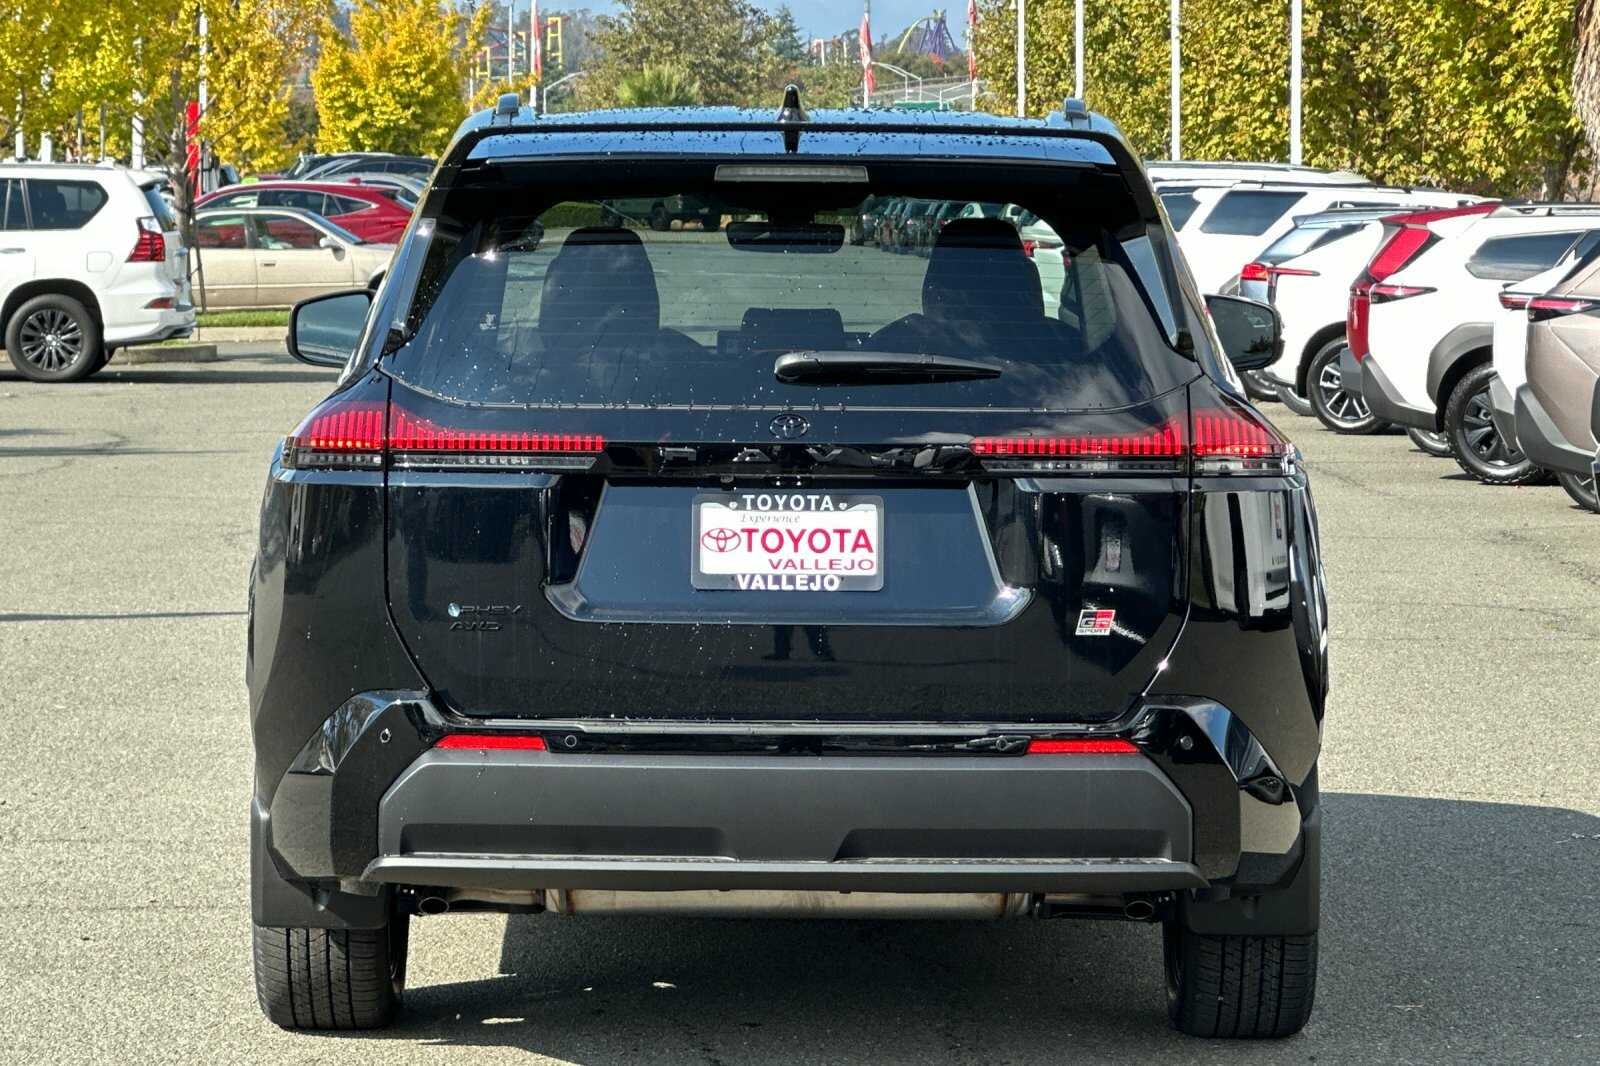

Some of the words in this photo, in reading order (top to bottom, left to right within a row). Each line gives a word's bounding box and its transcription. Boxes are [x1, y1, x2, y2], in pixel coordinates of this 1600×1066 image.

[742, 494, 834, 511] TOYOTA
[740, 512, 801, 524] Experience
[740, 528, 874, 554] TOYOTA
[768, 558, 875, 571] VALLEJO
[736, 574, 840, 591] VALLEJO
